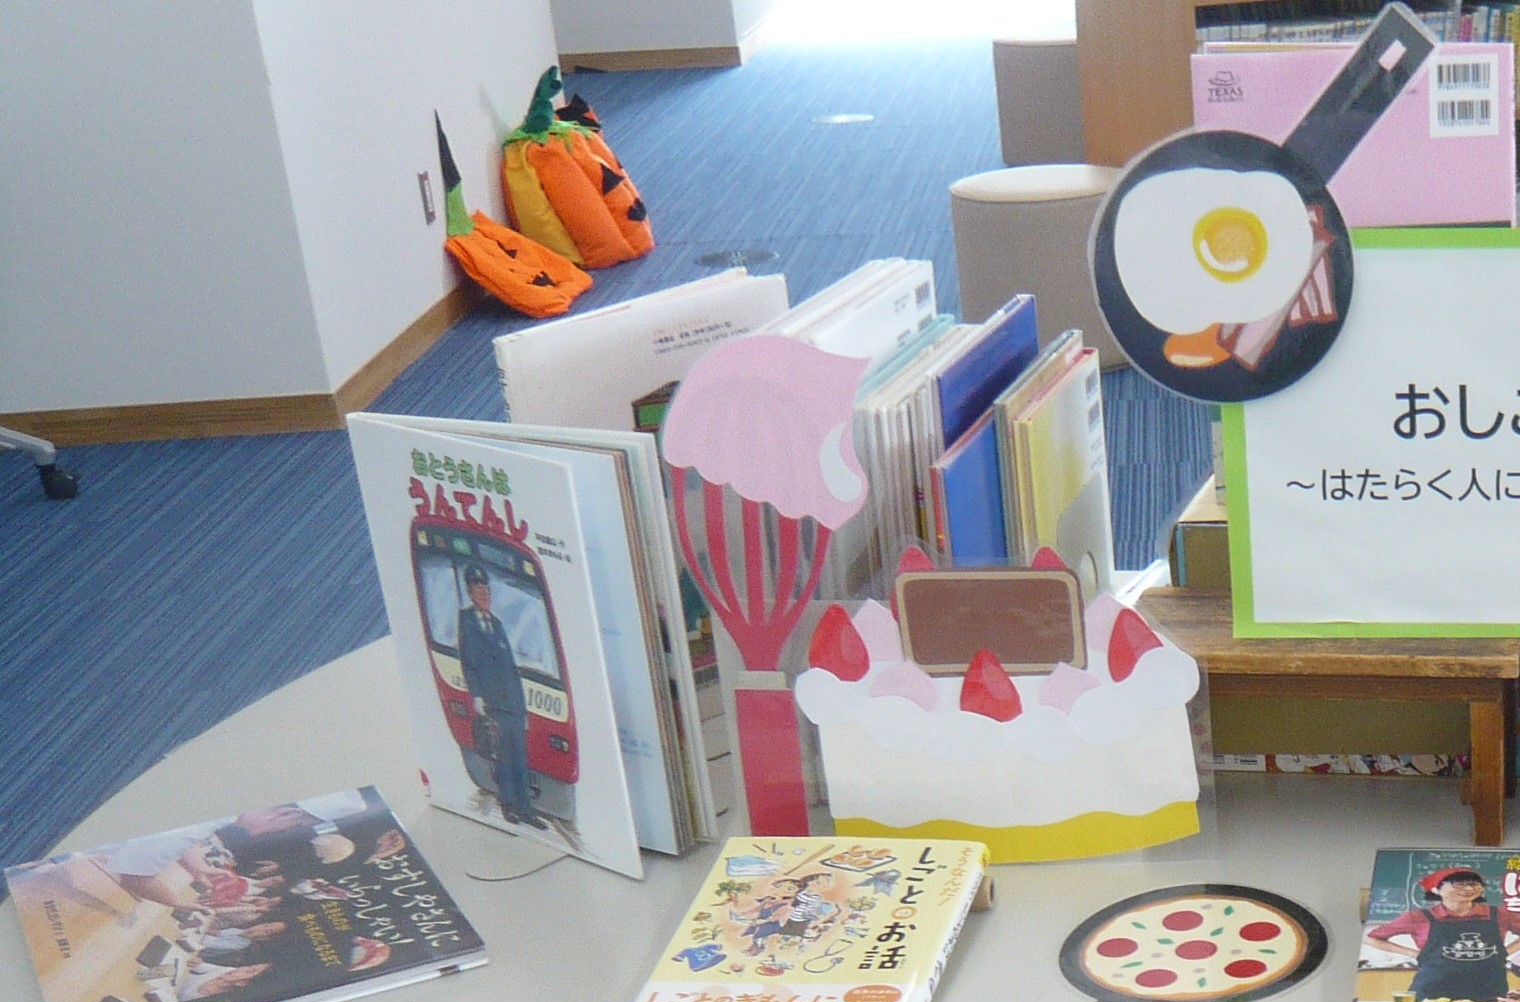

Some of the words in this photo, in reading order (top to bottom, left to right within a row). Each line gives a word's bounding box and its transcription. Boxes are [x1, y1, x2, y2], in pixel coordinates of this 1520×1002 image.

[1207, 87, 1244, 98] TEXAS
[410, 447, 512, 496] おとうさんは
[408, 476, 529, 542] うんてんし
[527, 687, 562, 716] 1000
[374, 853, 462, 948] おすしやさんに
